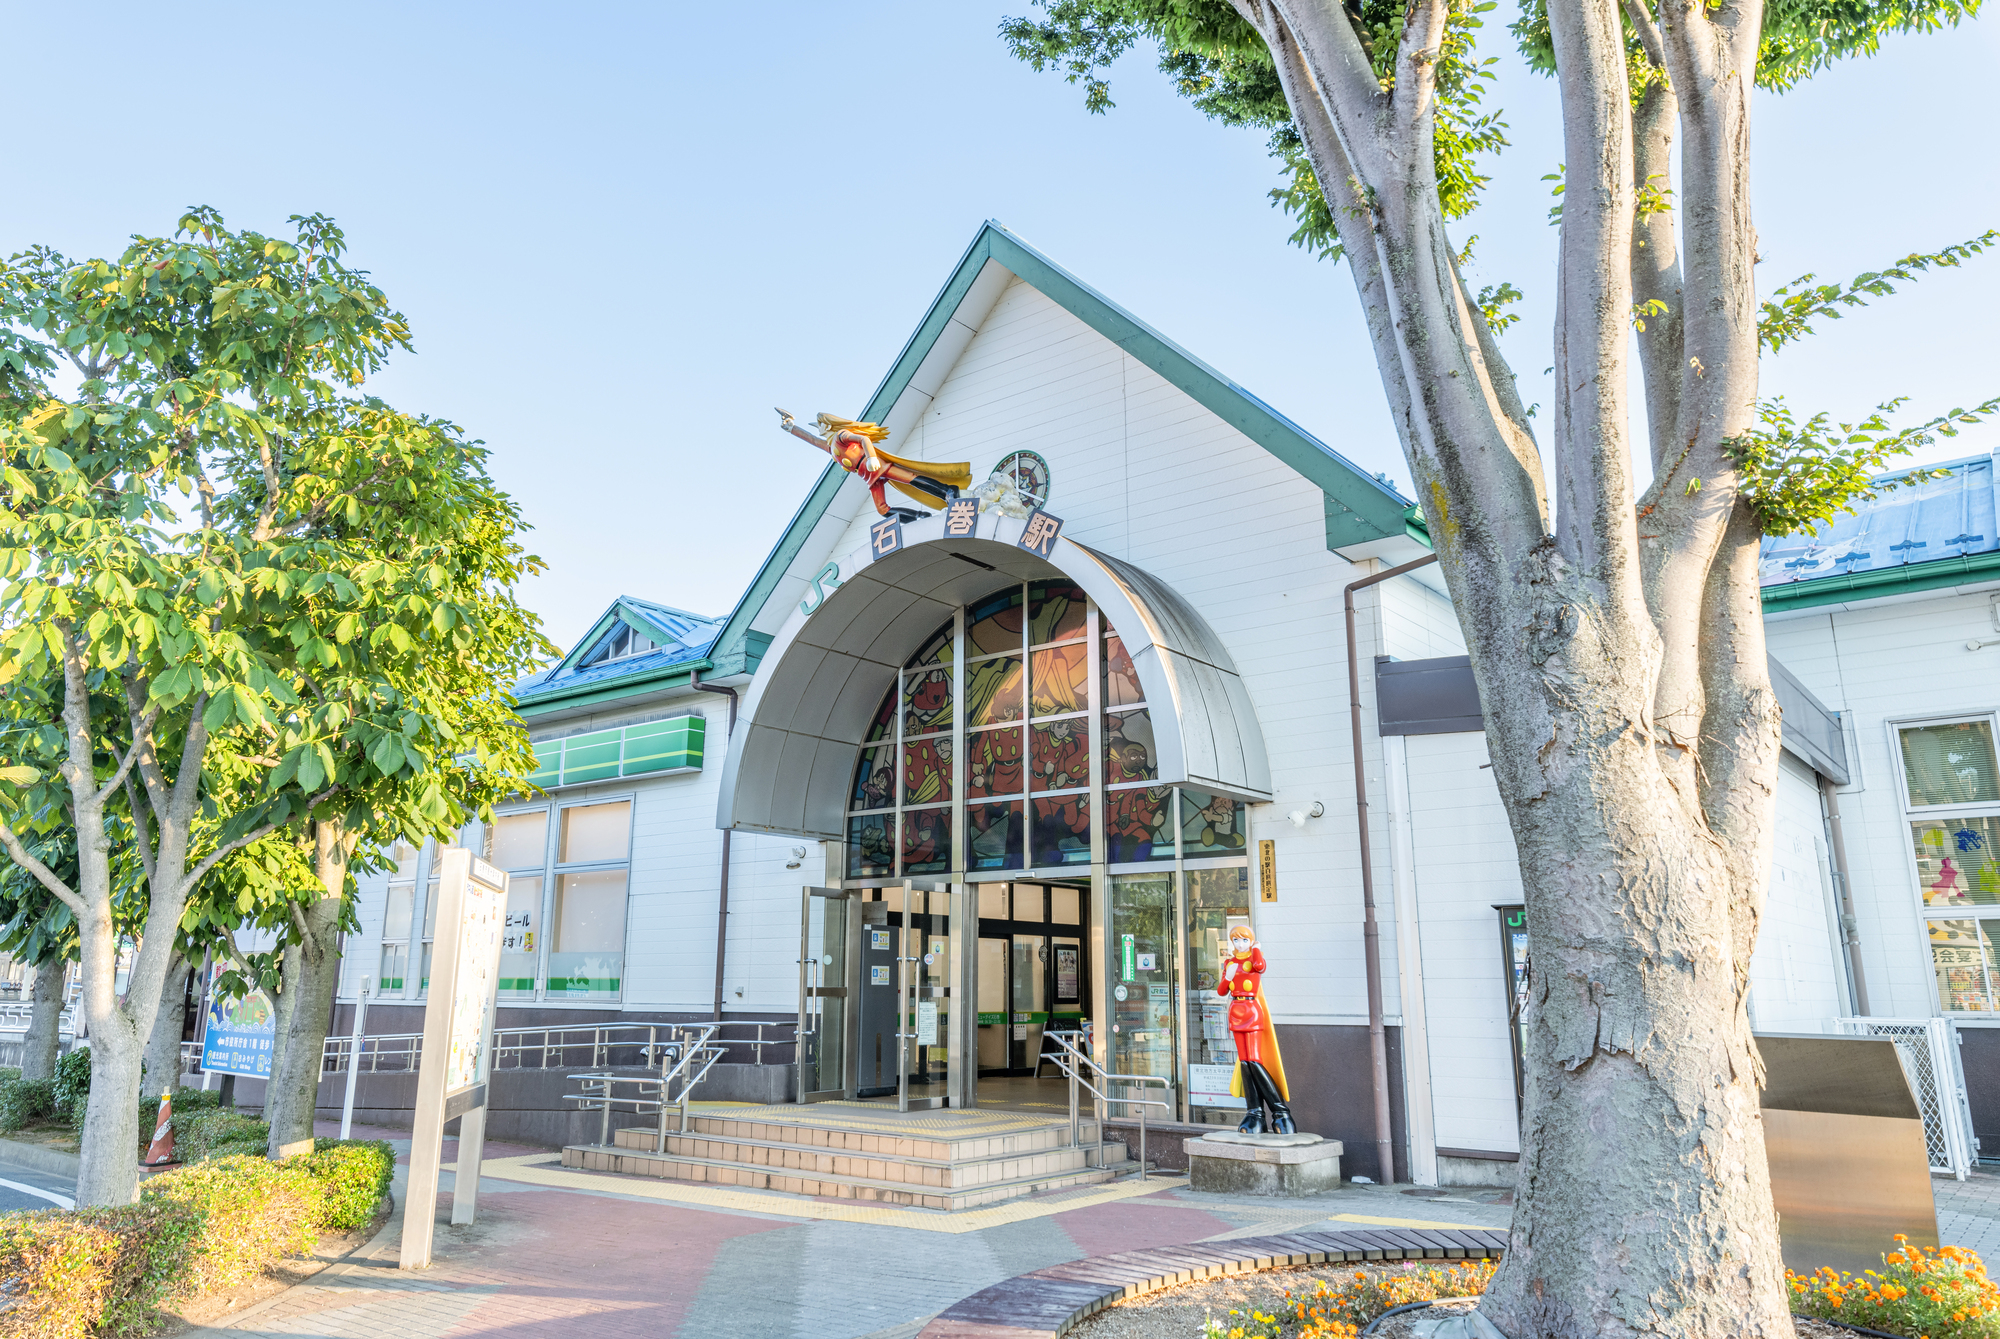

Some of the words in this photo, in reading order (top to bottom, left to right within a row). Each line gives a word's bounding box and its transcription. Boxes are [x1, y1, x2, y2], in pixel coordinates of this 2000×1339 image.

[873, 500, 1059, 555] 石巻駅
[800, 561, 844, 616] JR
